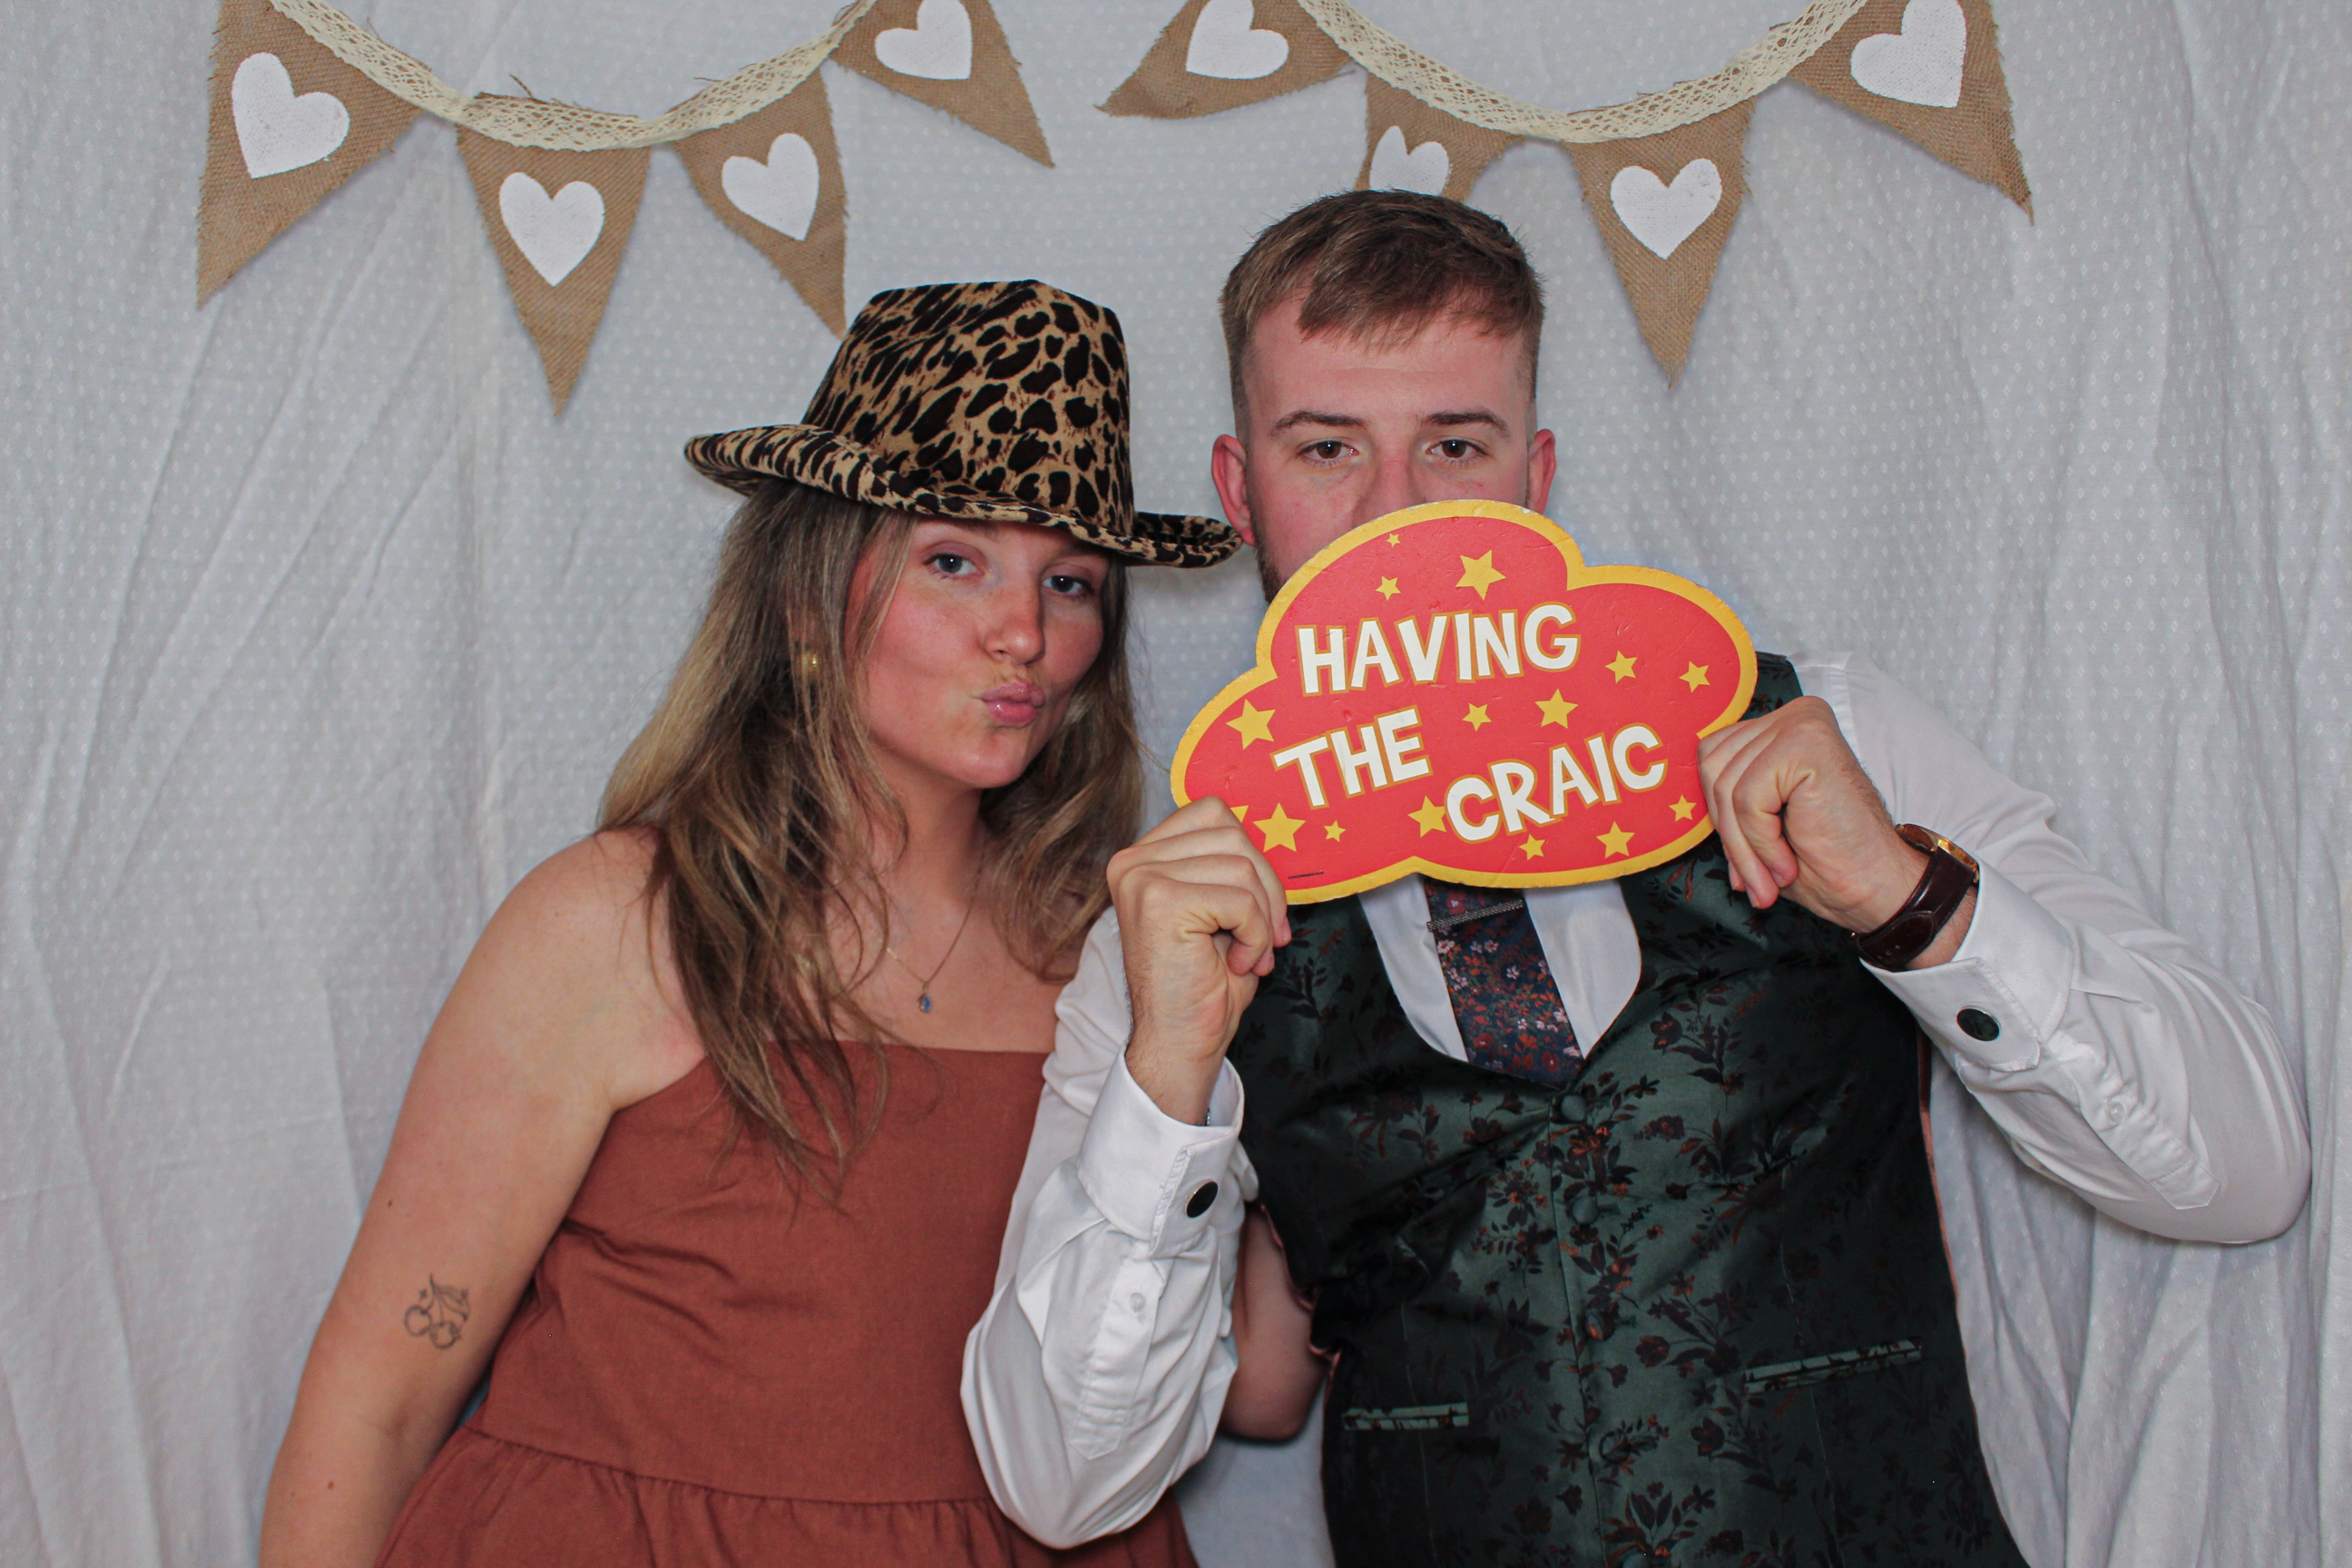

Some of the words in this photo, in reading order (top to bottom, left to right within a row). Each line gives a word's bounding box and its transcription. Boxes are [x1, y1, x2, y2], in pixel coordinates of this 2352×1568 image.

[1298, 604, 1579, 694] HAVING
[1273, 708, 1429, 807] THE
[1446, 725, 1666, 841] CRAIC
